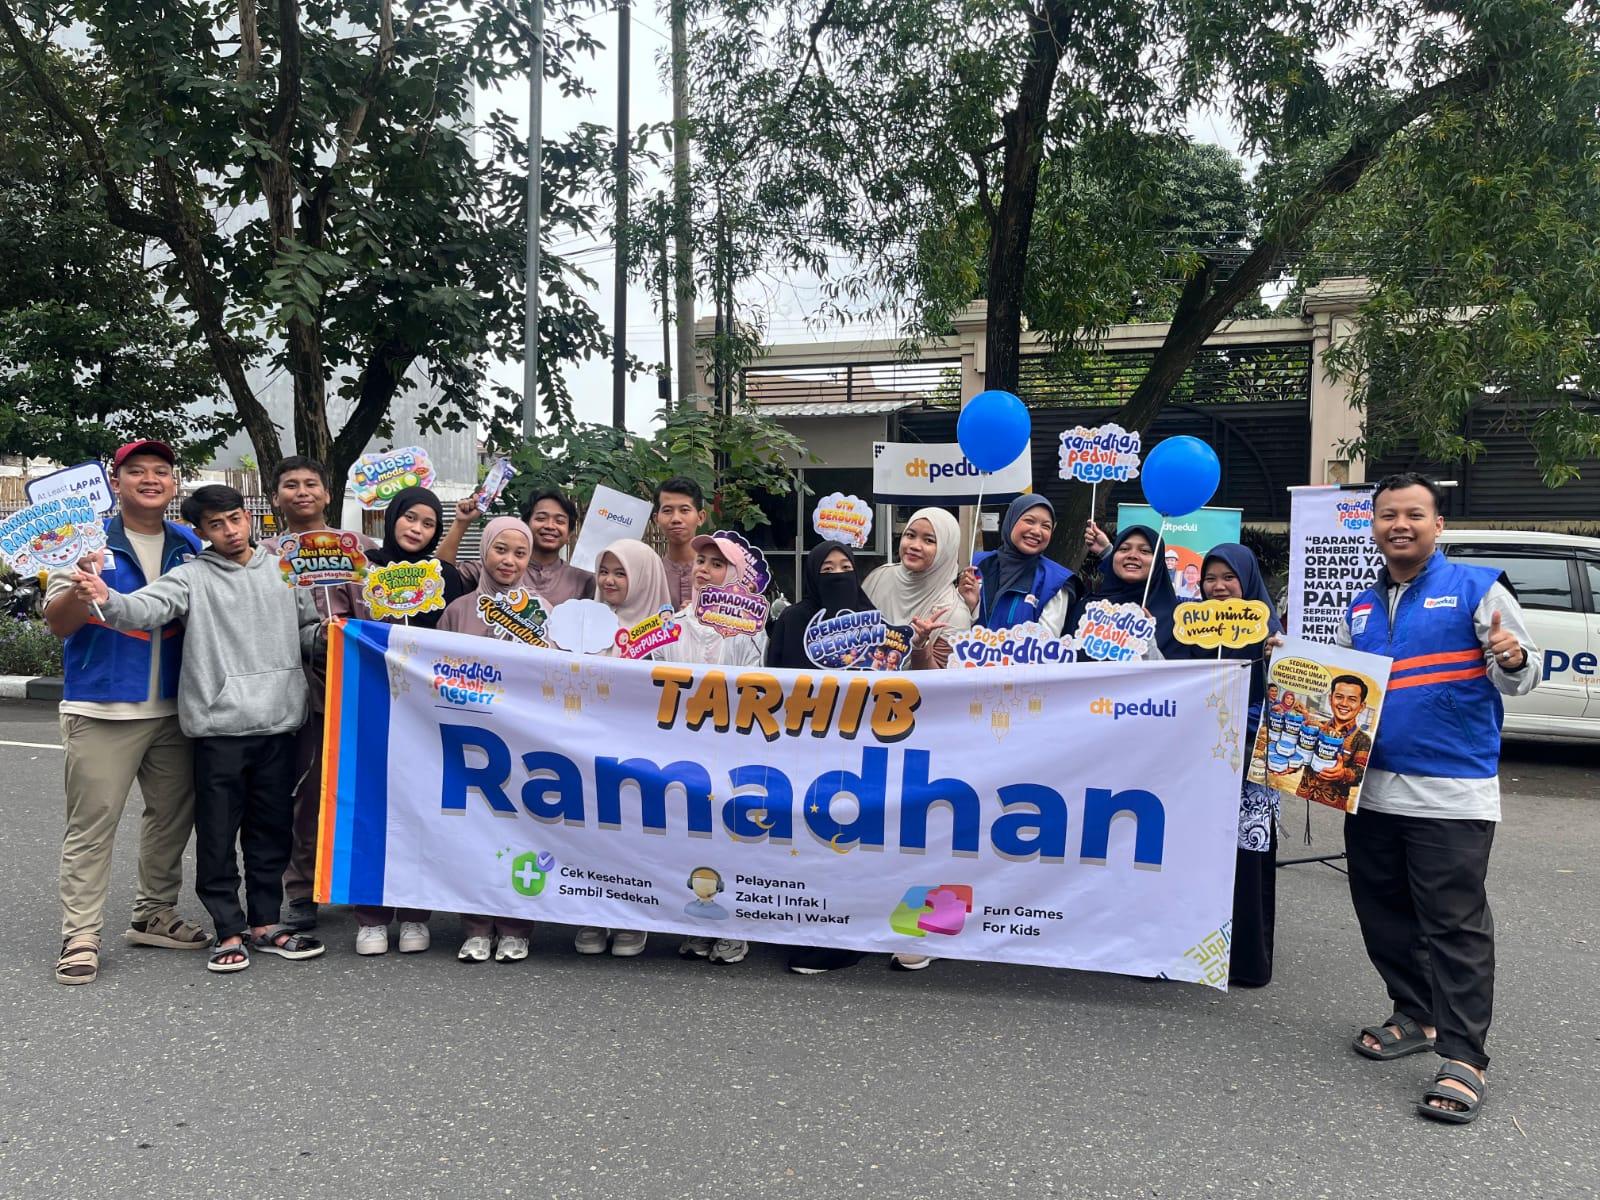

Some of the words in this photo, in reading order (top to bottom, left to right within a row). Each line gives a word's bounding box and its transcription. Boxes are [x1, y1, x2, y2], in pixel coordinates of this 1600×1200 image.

[1064, 433, 1139, 454] ramadhan
[1068, 447, 1118, 467] peduli
[362, 453, 415, 480] Puasa
[378, 466, 405, 481] mode
[905, 457, 993, 483] dtpedu
[1073, 463, 1129, 481] negeri
[70, 477, 101, 491] LAPAR
[381, 480, 403, 495] ON
[0, 508, 94, 555] RAMADHAN
[300, 547, 318, 557] Aku
[320, 547, 342, 557] Kuat
[1305, 546, 1358, 555] MEMBERI
[291, 556, 353, 574] PUASA
[1305, 556, 1358, 566] ORANG
[378, 568, 426, 582] PEMBURU
[386, 576, 420, 589] TAKJIL
[1304, 581, 1342, 590] MAKA
[702, 591, 765, 617] RAMADHAN
[719, 606, 742, 618] FULL
[1087, 607, 1153, 638] ramadhan
[1183, 610, 1209, 625] AKU
[1216, 606, 1261, 620] minta
[631, 619, 660, 639] Selamat
[809, 612, 881, 640] PEMBURU
[1082, 621, 1129, 648] peduli
[1187, 623, 1226, 636] maaf
[808, 626, 885, 660] BERKAH
[974, 628, 1006, 646] 2026
[956, 637, 1074, 666] ramadhan
[1084, 635, 1134, 660] negeri
[434, 662, 502, 683] ramadhan
[1289, 659, 1319, 671] SEDIAKAN
[434, 675, 484, 692] peduli
[1273, 671, 1297, 681] UNGGUL
[1305, 678, 1328, 688] RUMAH
[1308, 671, 1328, 680] UMAT
[440, 685, 495, 705] negeri
[651, 666, 922, 743] TARHIB
[1089, 697, 1177, 720] dtpeduli
[440, 723, 1166, 872] Ramadhan
[560, 867, 584, 879] Cek
[587, 871, 652, 888] Kesehatan
[735, 875, 806, 890] Pelayanan
[559, 885, 603, 898] Sambil
[606, 889, 660, 905] Sedekah
[735, 891, 774, 904] Zakat
[785, 896, 819, 908] Infak
[735, 908, 794, 921] Sedekah
[805, 913, 850, 924] Wakaf
[983, 906, 1010, 916] Fun
[1014, 906, 1064, 920] Games
[983, 922, 1006, 933] For
[1010, 924, 1041, 936] Kids
